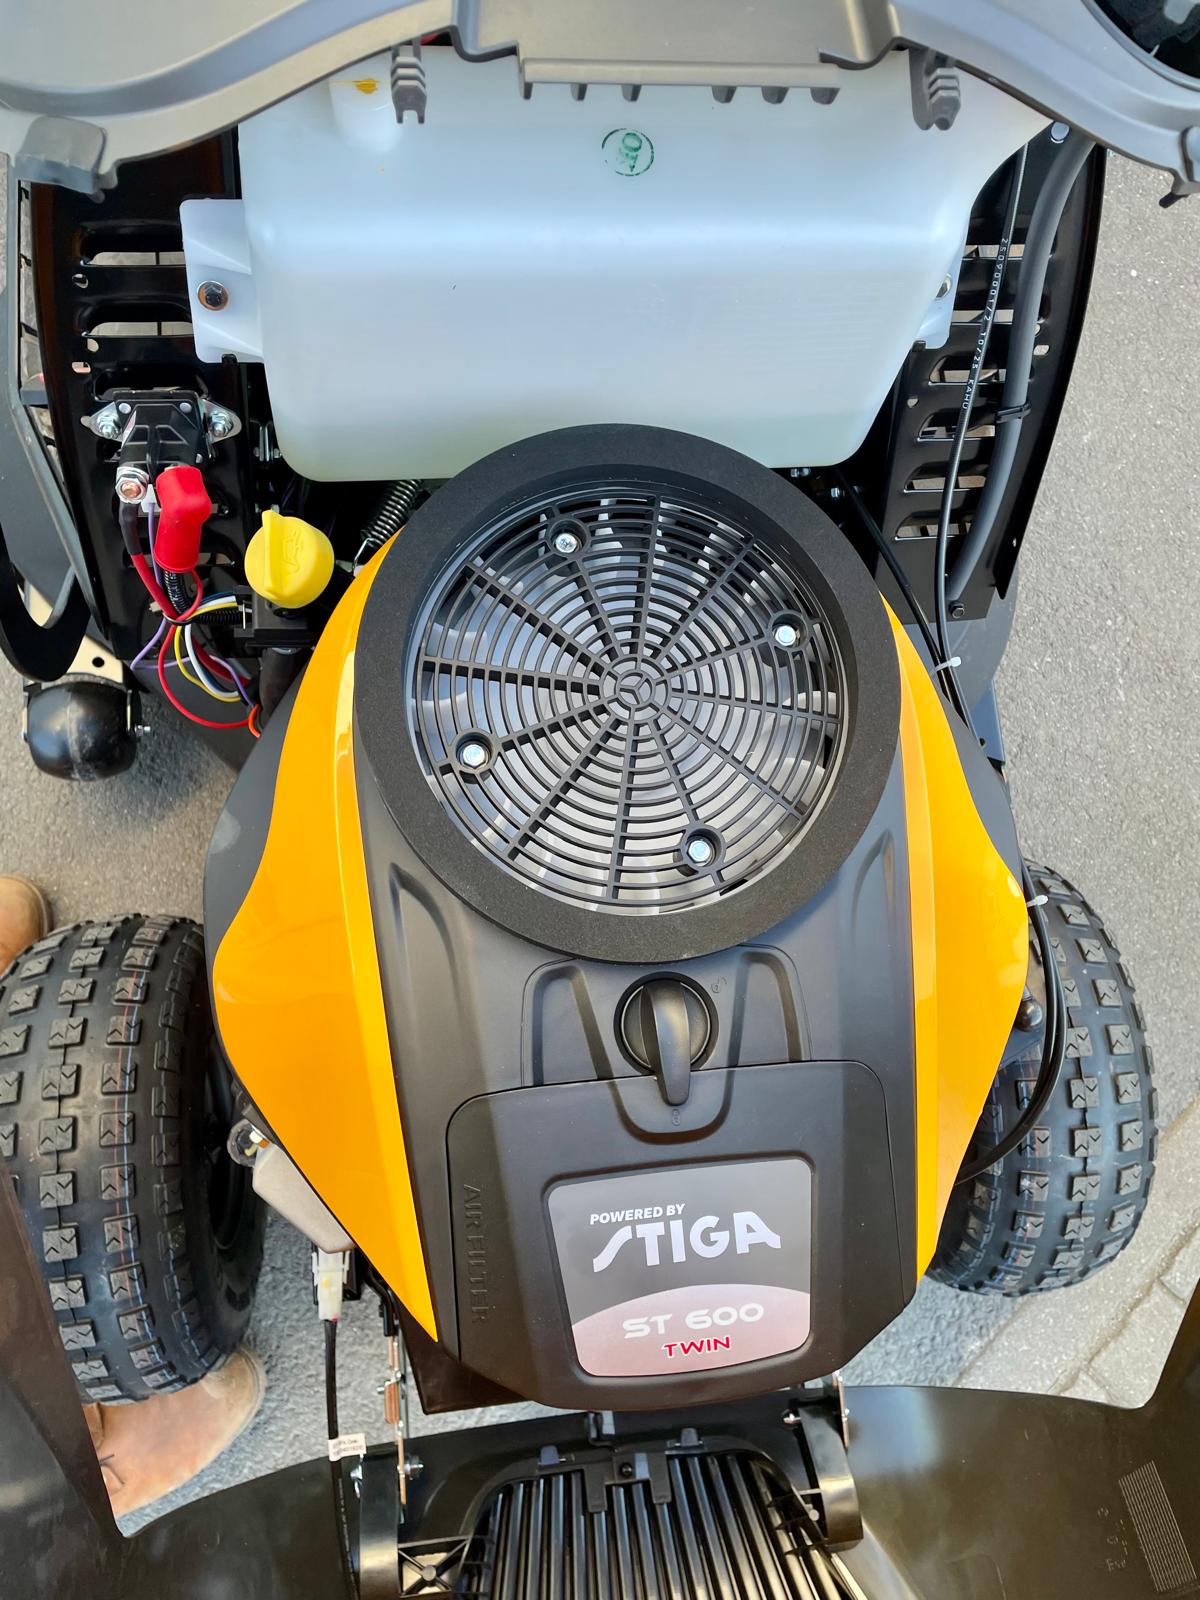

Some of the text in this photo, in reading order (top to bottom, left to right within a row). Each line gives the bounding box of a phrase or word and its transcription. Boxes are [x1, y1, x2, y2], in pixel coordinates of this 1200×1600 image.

[589, 1203, 686, 1225] POWERED BY
[463, 1184, 489, 1324] AIR FILTER
[592, 1211, 782, 1273] STIGA
[622, 1302, 765, 1339] ST 600
[661, 1335, 732, 1359] TWIN
